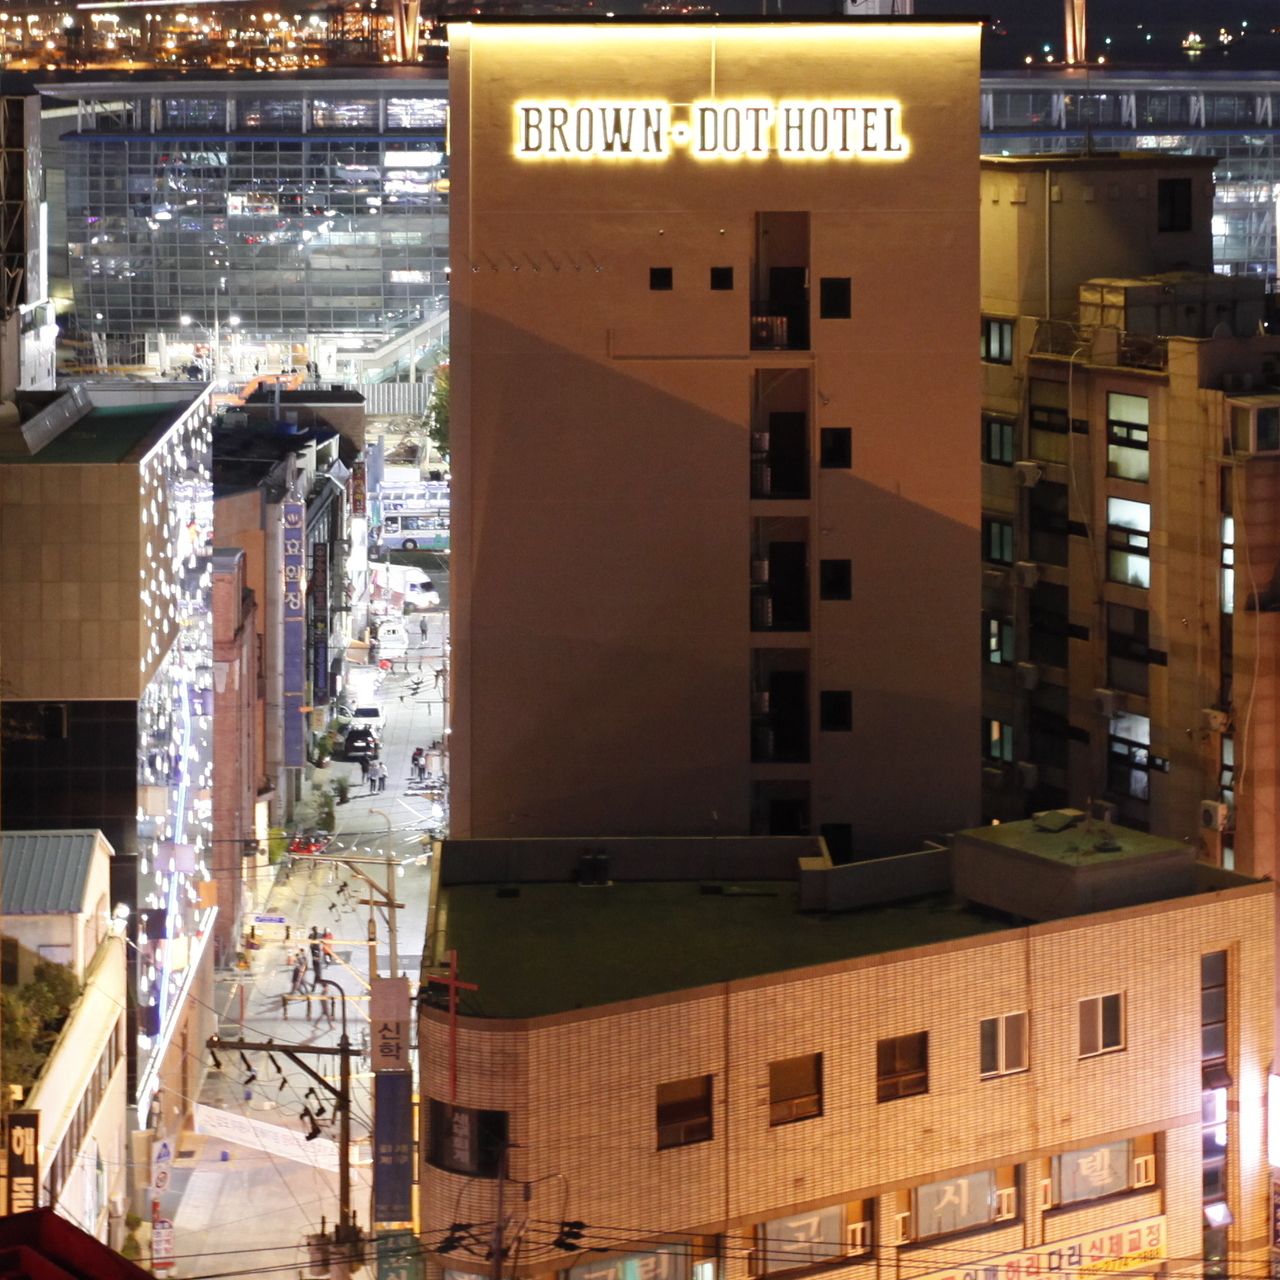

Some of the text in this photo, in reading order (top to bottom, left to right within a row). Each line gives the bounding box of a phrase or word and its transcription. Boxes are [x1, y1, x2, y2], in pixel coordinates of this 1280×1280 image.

[519, 106, 904, 154] BROWN DOT HOTEL
[378, 1022, 402, 1061] 신학
